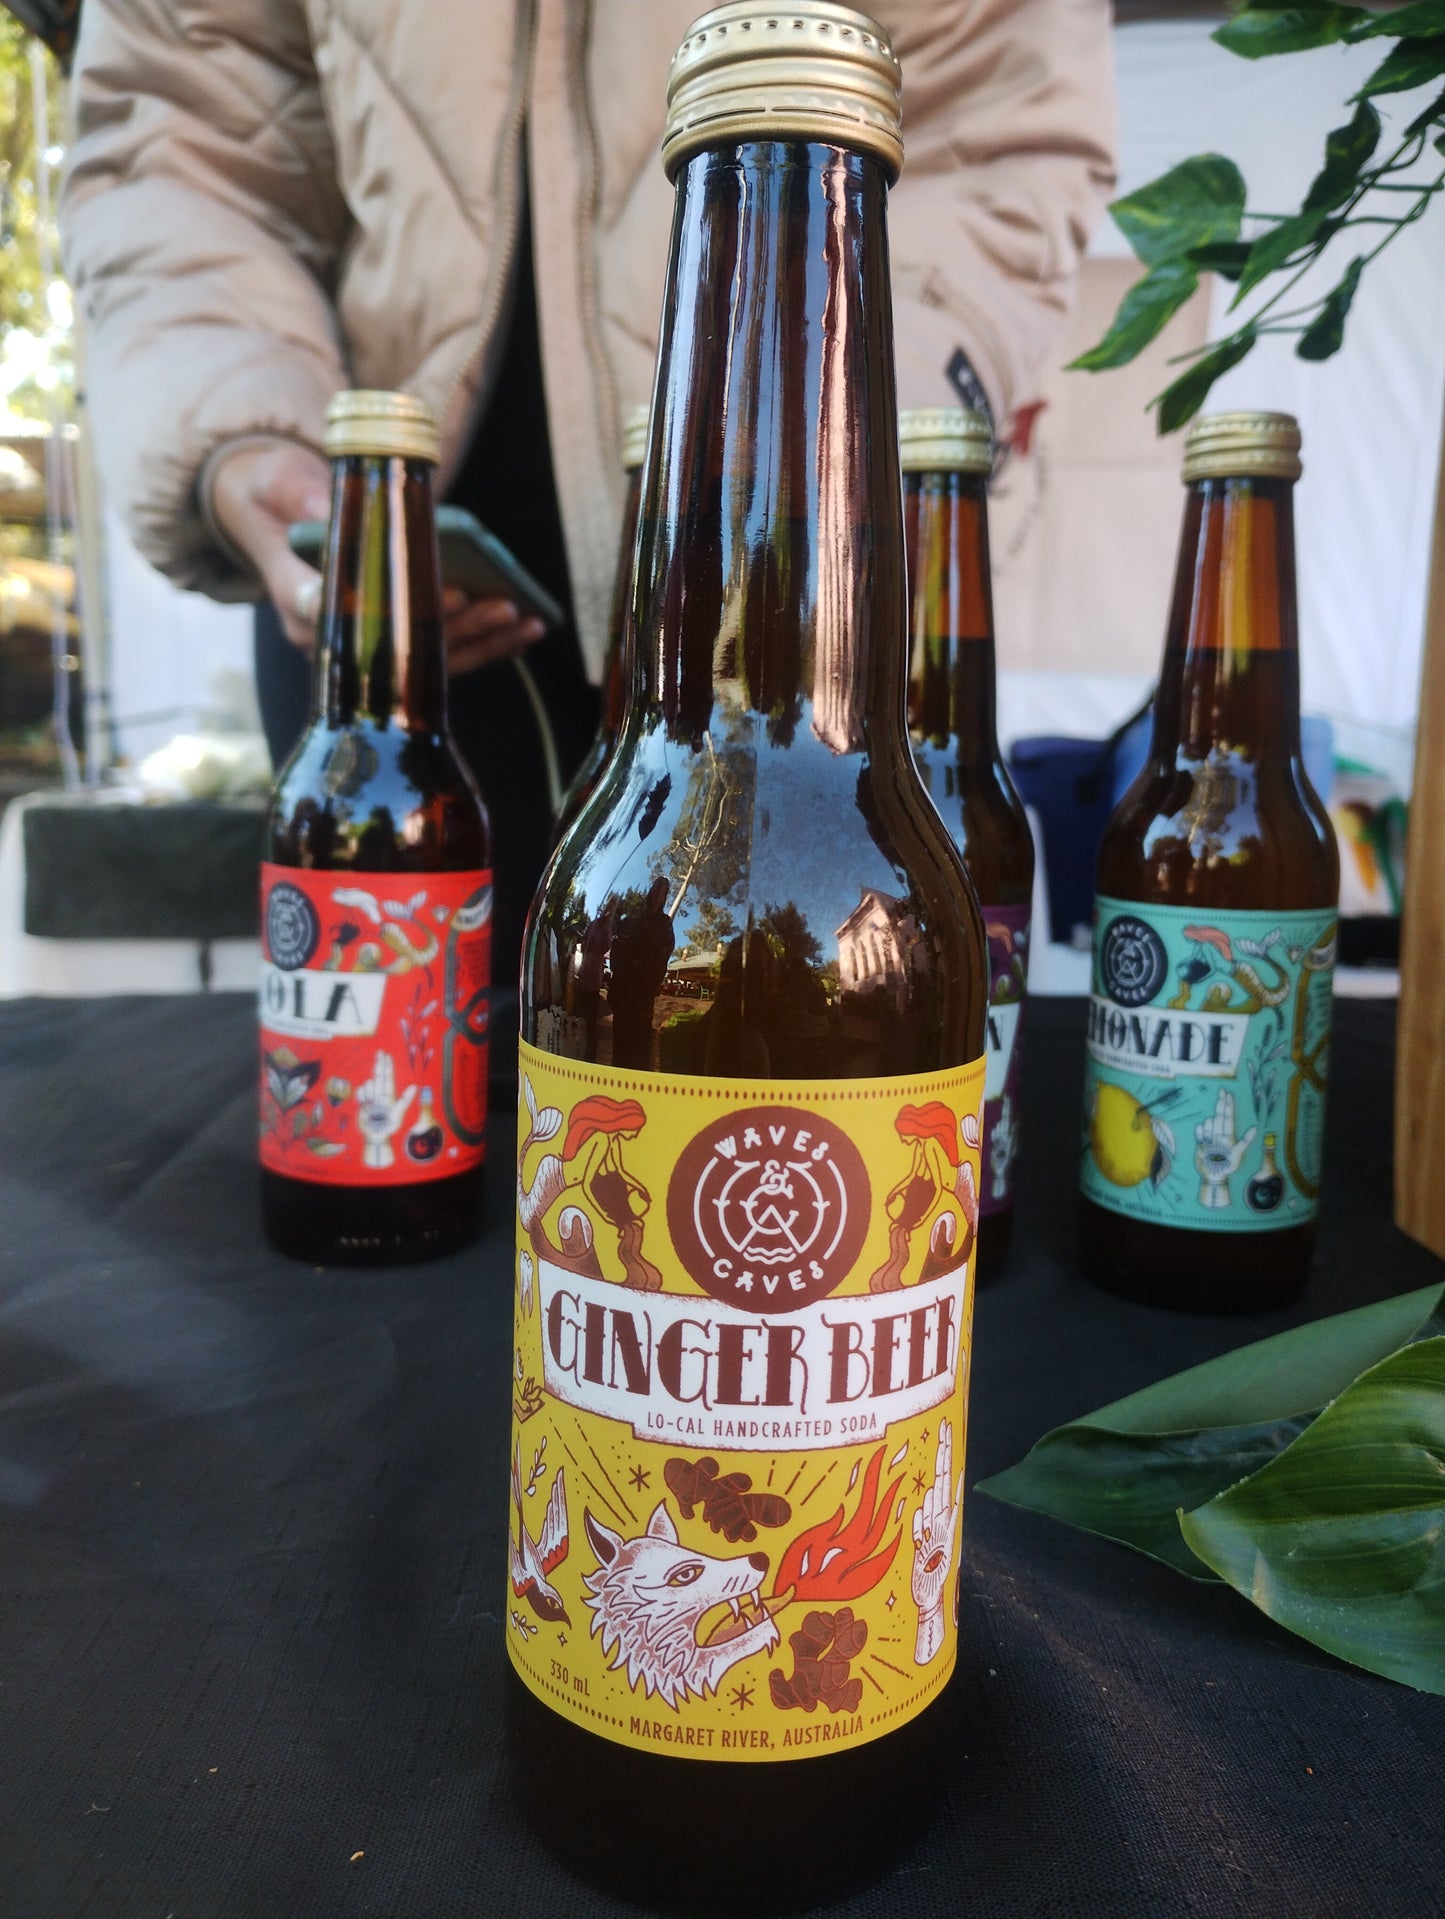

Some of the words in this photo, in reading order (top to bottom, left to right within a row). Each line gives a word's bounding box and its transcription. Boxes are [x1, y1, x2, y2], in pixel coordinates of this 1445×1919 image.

[714, 1125, 828, 1162] WAVES
[713, 1258, 825, 1295] CAVES
[545, 1289, 809, 1415] GINGER
[821, 1294, 957, 1404] BEER
[647, 1412, 705, 1435] LO-CAL
[713, 1419, 832, 1438] HANDCRAFTED
[840, 1412, 878, 1434] SODA
[549, 1658, 570, 1686] 330
[573, 1676, 591, 1697] mL
[629, 1715, 714, 1747] MARGARET
[721, 1729, 776, 1750] RIVER,
[782, 1718, 864, 1748] AUSTRALIA
